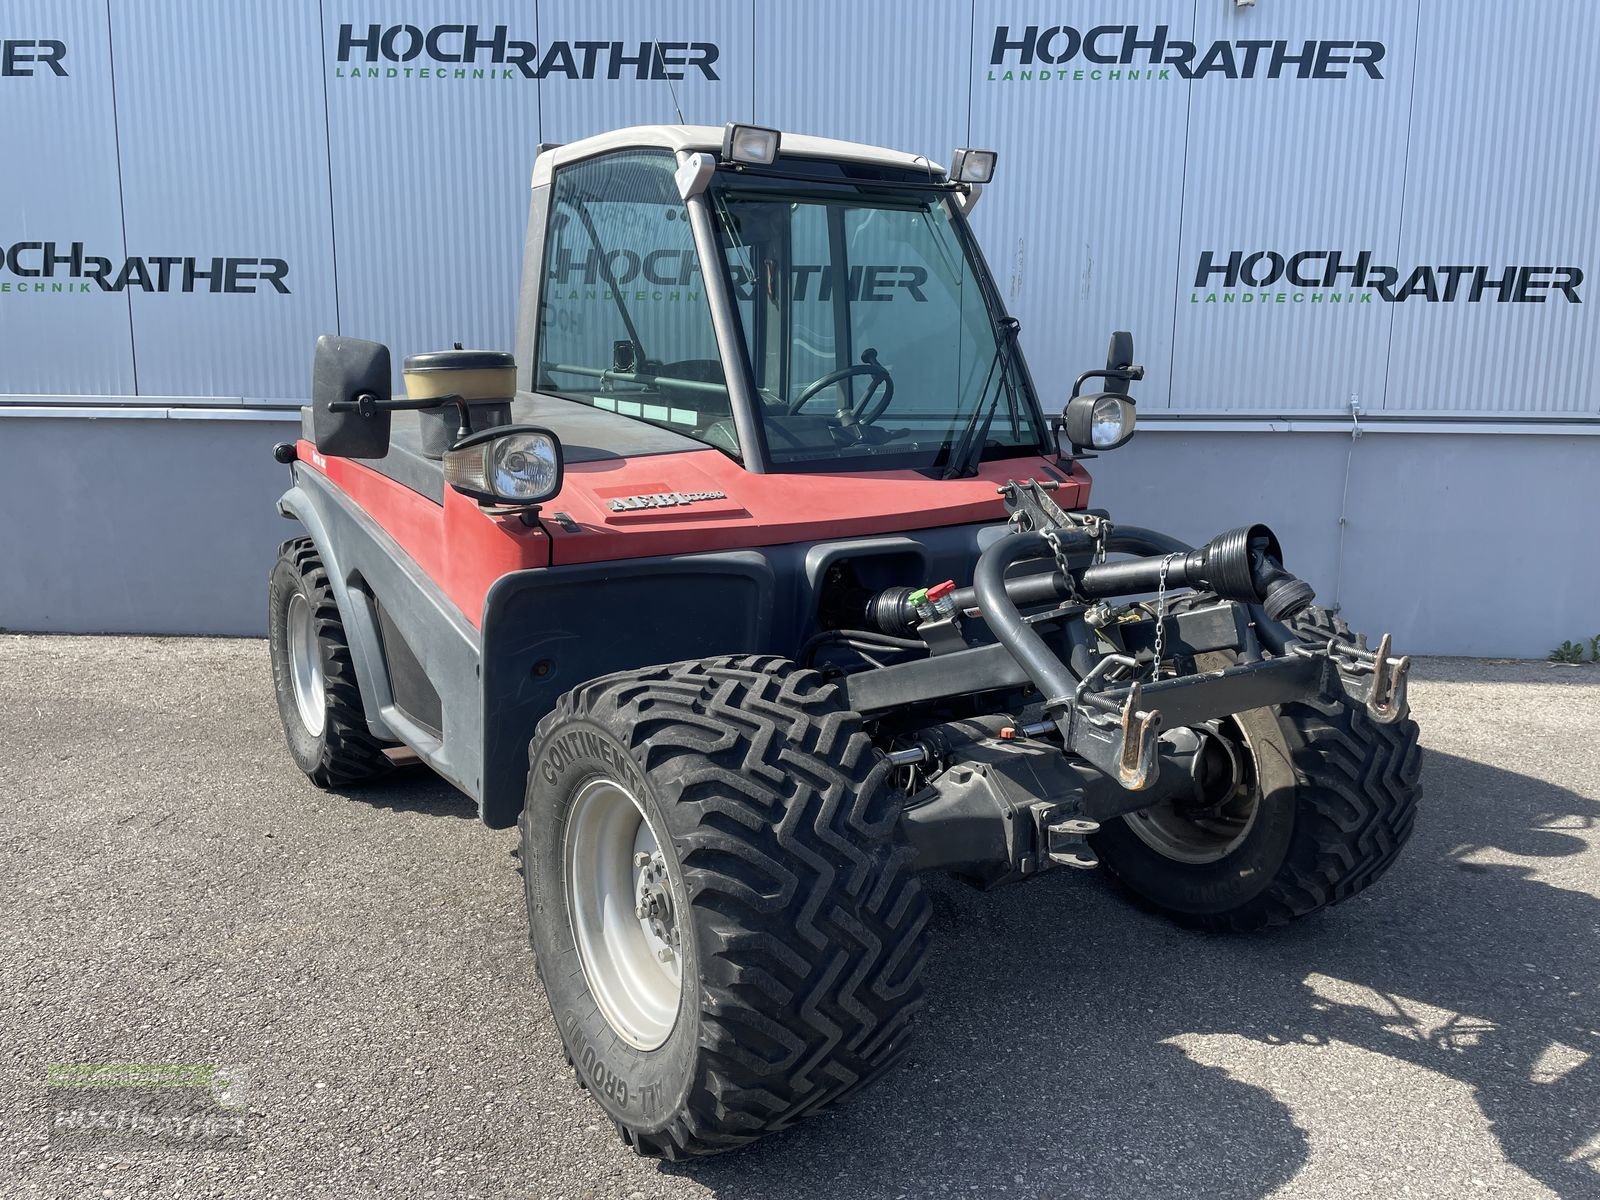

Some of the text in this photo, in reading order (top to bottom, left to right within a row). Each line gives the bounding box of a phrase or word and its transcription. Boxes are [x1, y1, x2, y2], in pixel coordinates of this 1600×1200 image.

[0, 39, 69, 77] ER
[336, 67, 514, 79] LANDTECHNIK
[337, 24, 721, 80] HOCHRATHER
[989, 25, 1386, 80] HOCHRATHER
[987, 69, 1171, 81] LANDTECHNIK
[0, 241, 292, 294] CHRATHER
[1194, 250, 1585, 304] HOCHRATHER
[1191, 292, 1372, 304] LANDTECHNIK
